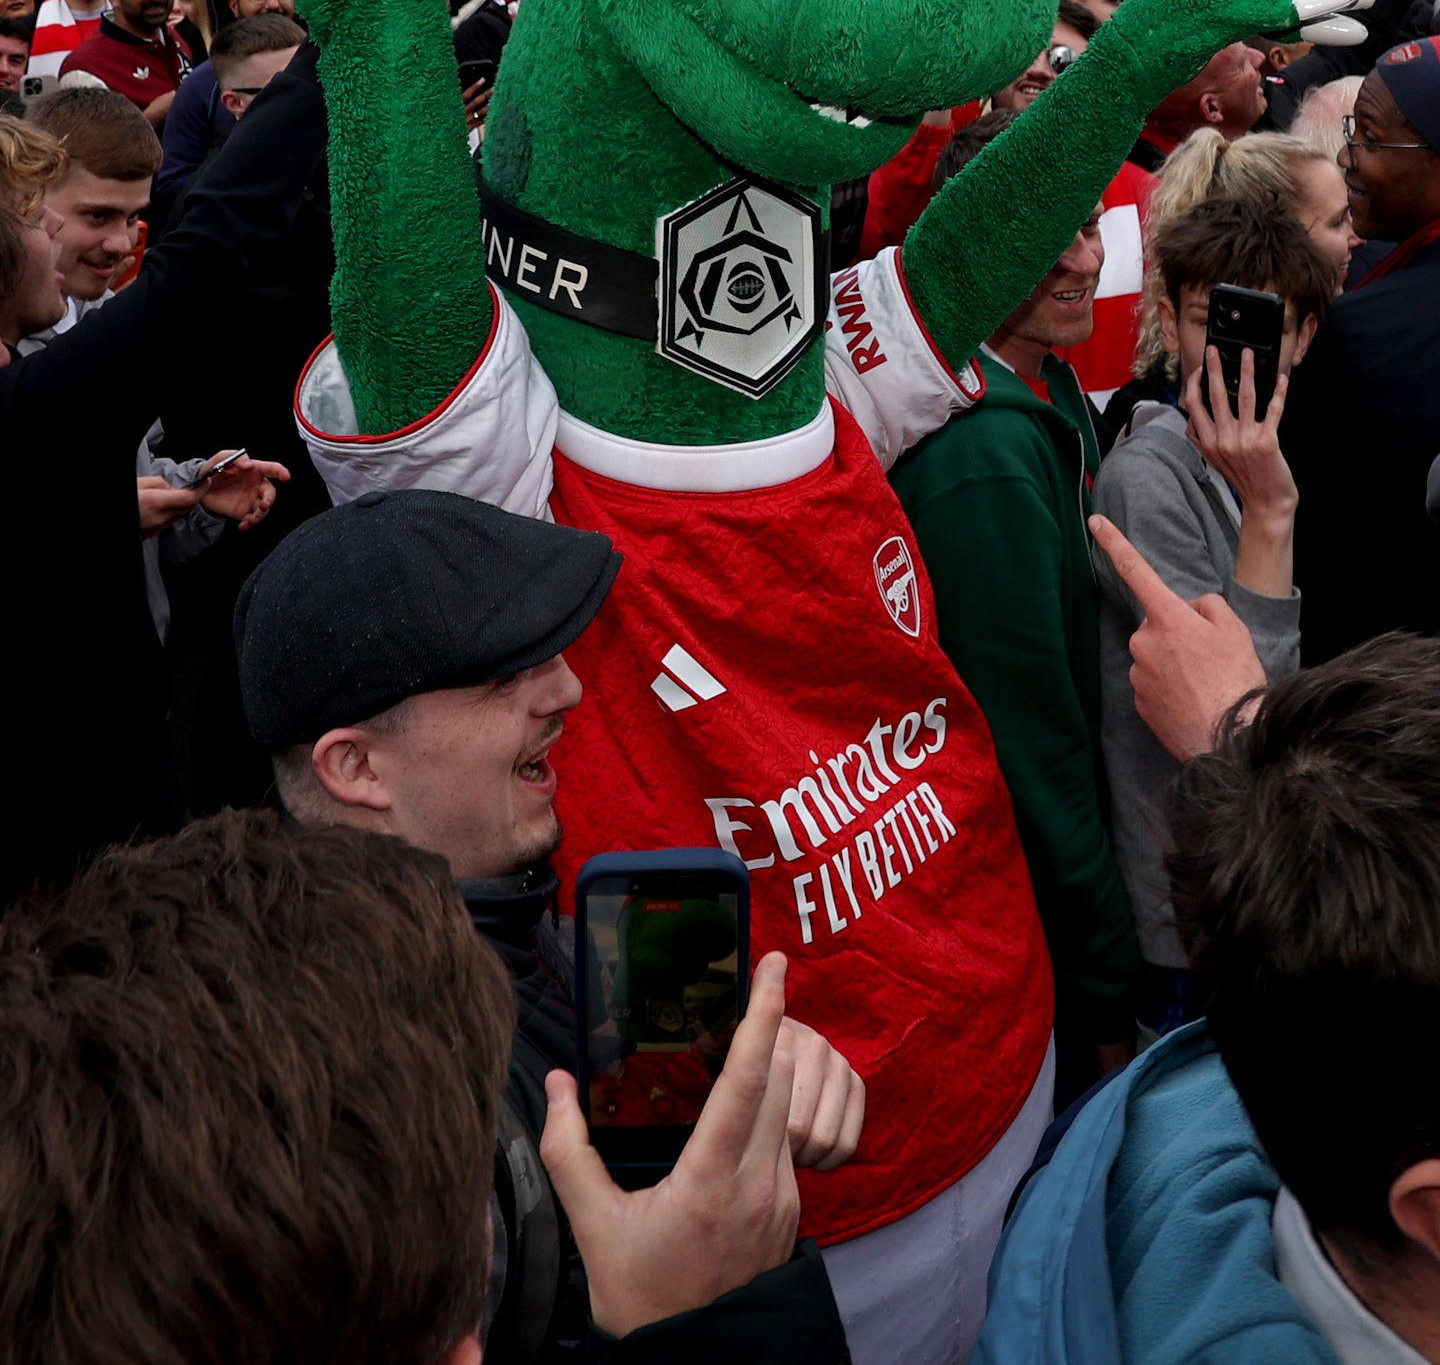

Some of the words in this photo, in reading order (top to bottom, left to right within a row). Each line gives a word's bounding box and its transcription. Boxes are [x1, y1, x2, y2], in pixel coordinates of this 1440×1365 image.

[879, 550, 906, 583] Arsenal
[704, 697, 948, 871] Emirates
[792, 847, 862, 944] FLY
[856, 781, 957, 901] BETTER
